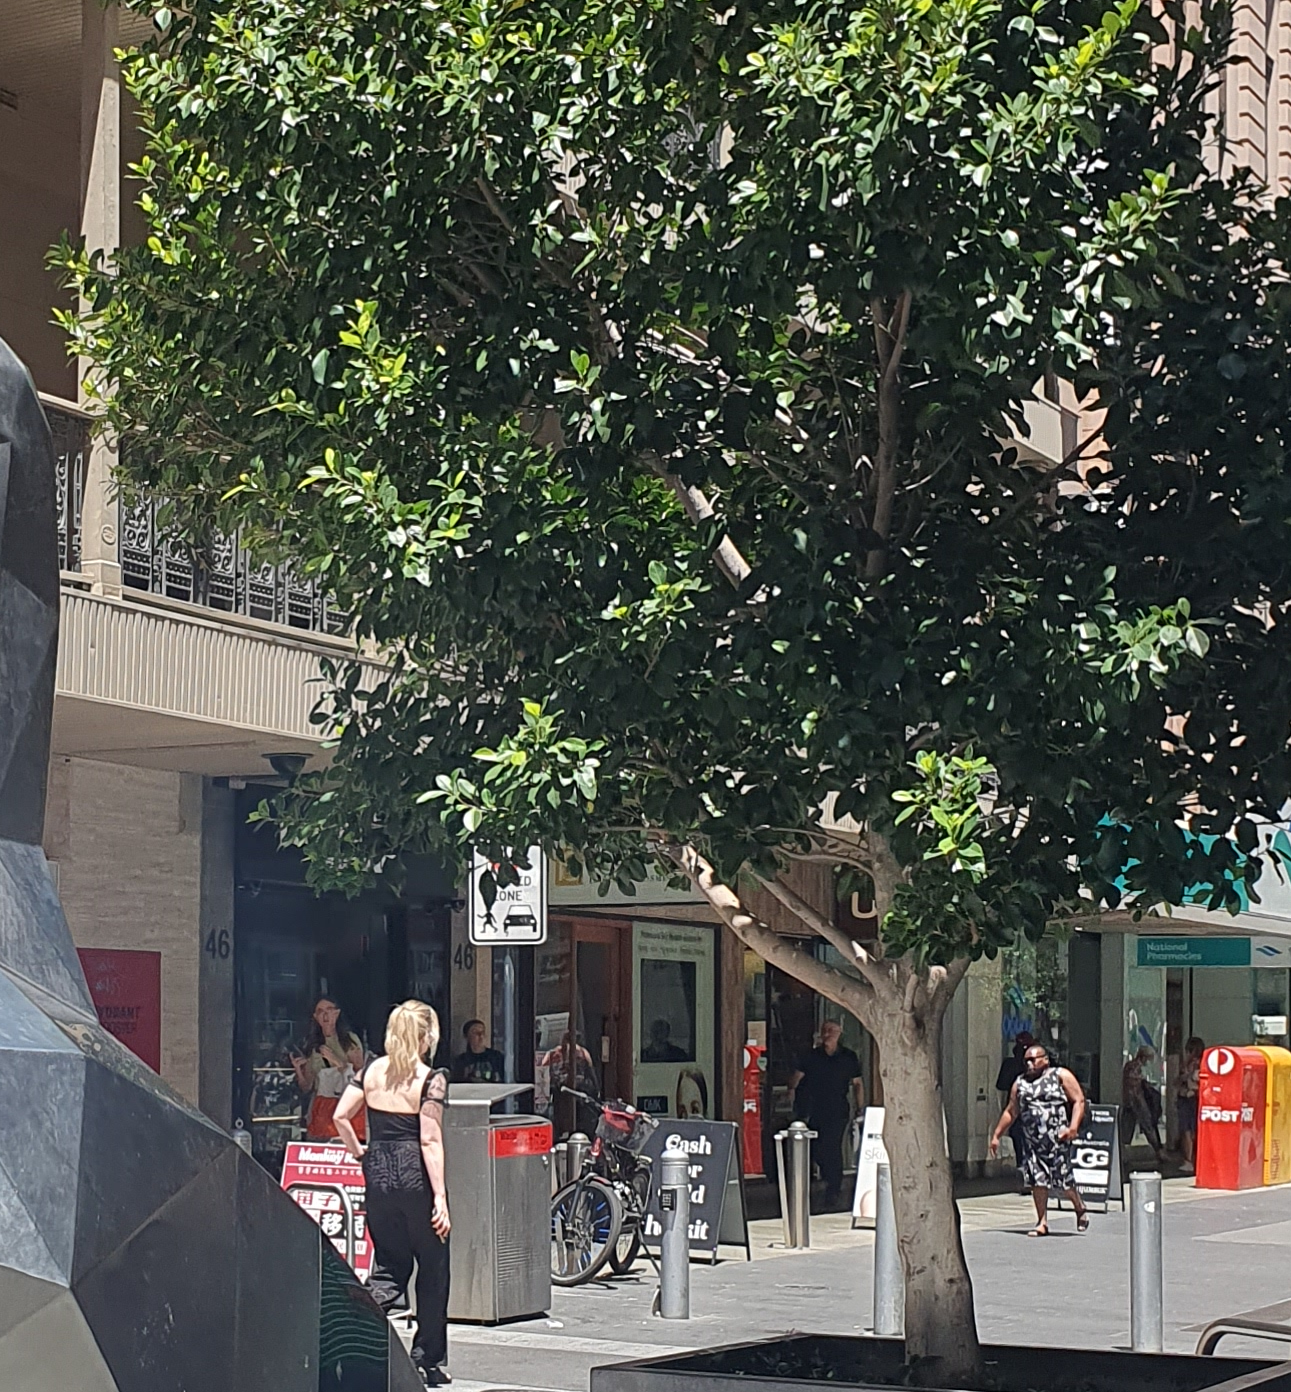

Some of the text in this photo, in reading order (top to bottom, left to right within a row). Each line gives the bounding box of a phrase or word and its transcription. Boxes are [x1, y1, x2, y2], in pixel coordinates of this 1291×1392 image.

[205, 928, 230, 960] 46
[1146, 943, 1188, 951] National
[454, 943, 473, 970] 46
[1147, 952, 1202, 961] Pharmacies
[1200, 1109, 1240, 1122] POST
[665, 1134, 712, 1155] Cash
[298, 1147, 345, 1165] Monkey
